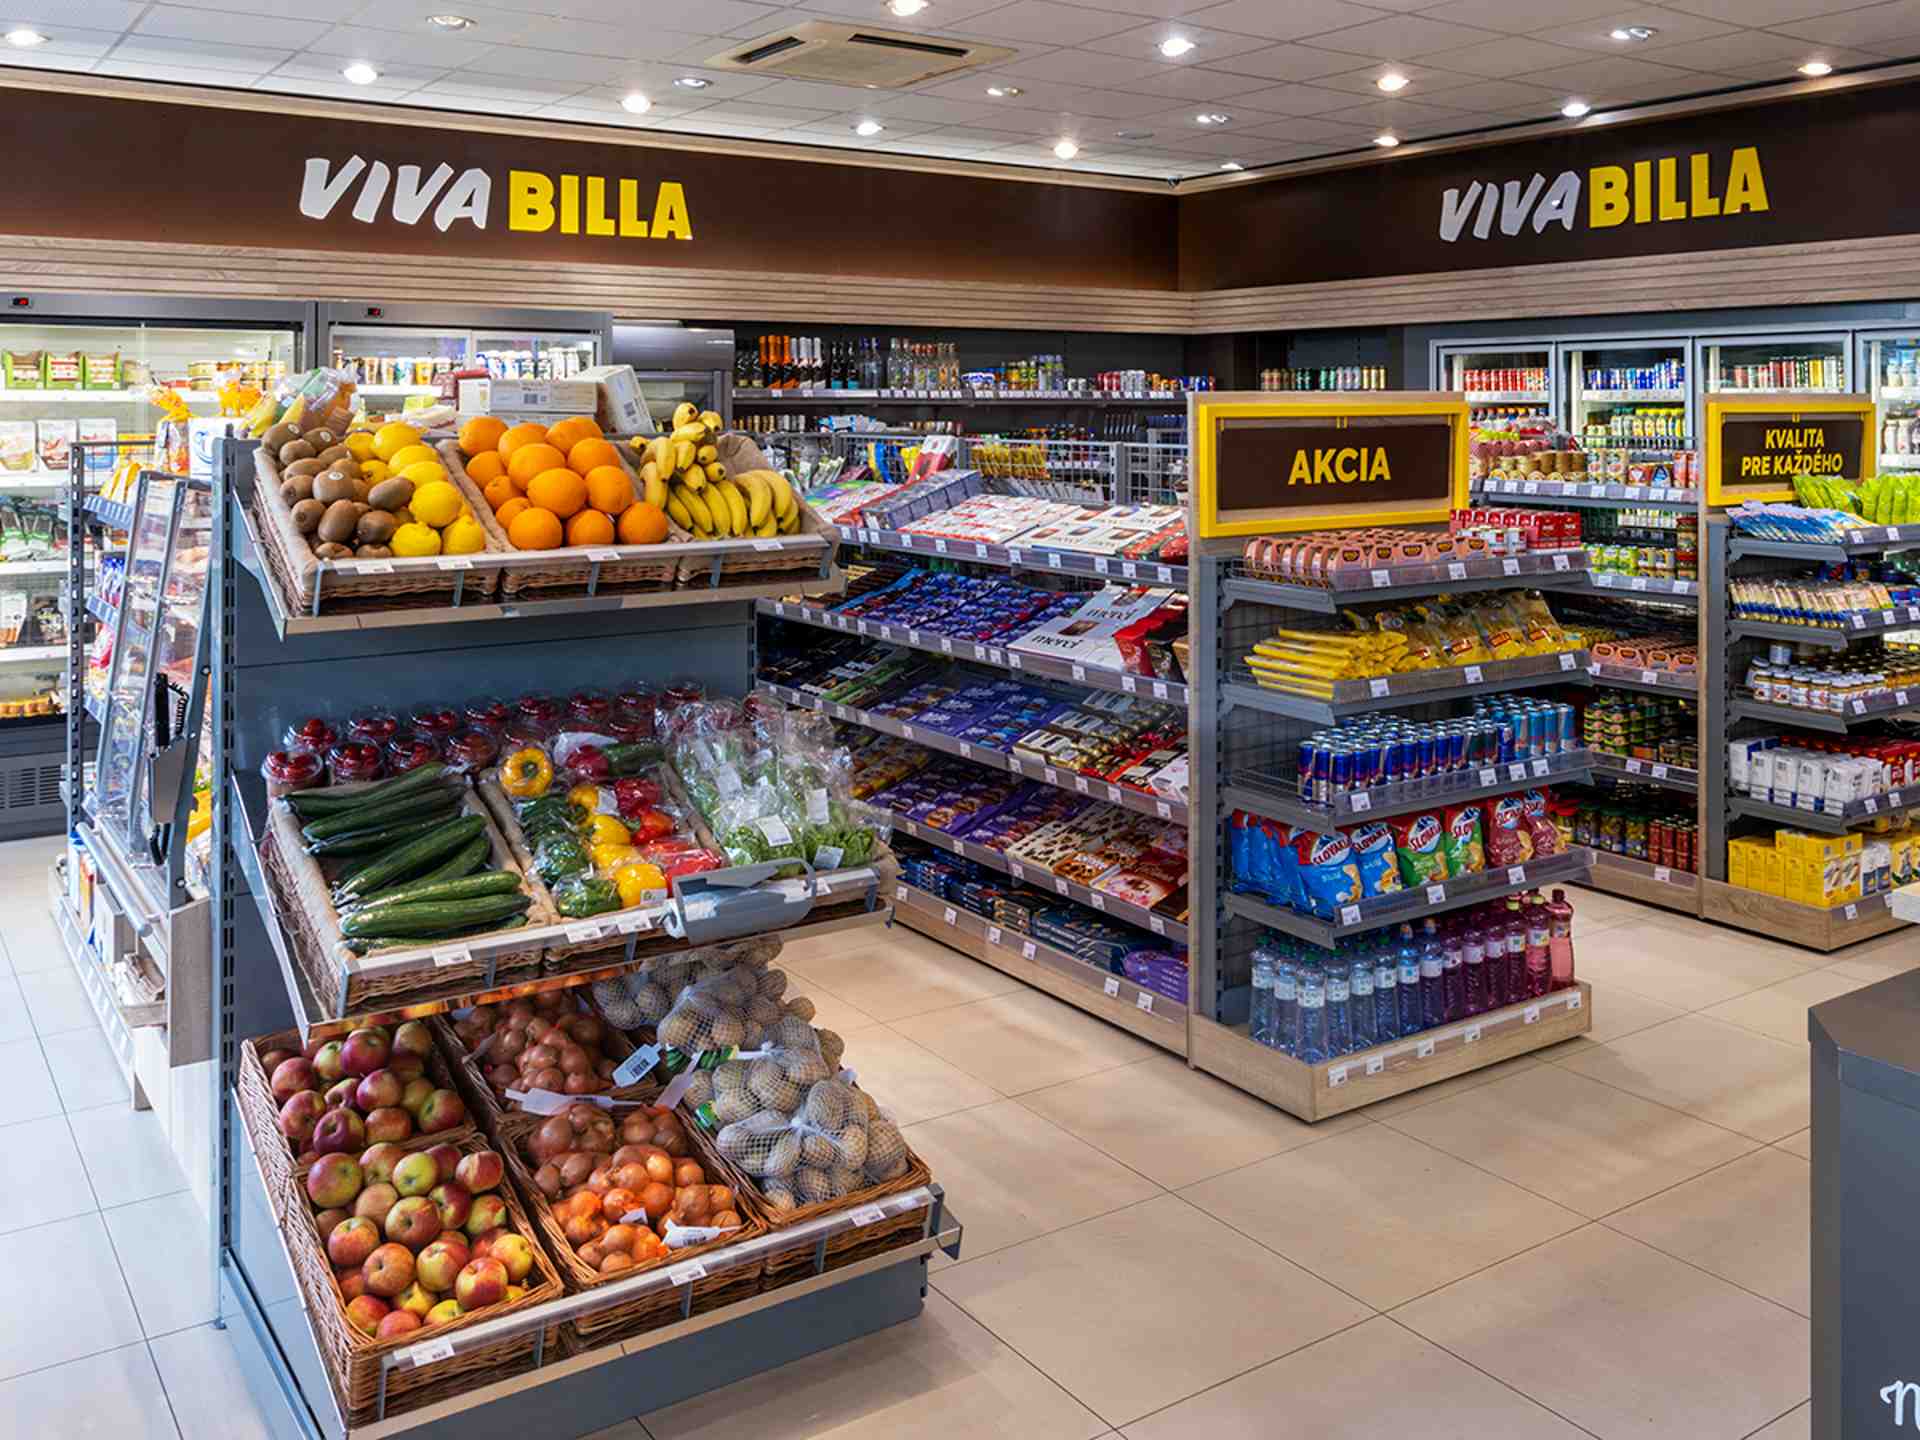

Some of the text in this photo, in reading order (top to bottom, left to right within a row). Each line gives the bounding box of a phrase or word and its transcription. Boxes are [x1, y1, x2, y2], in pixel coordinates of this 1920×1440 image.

[300, 154, 693, 240] VIVA BILLA
[1439, 146, 1769, 242] VIVA BILLA
[1765, 428, 1825, 449] KVALITA
[1287, 447, 1392, 485] AKCIA
[1741, 448, 1843, 476] PRE KAŽDÉHO
